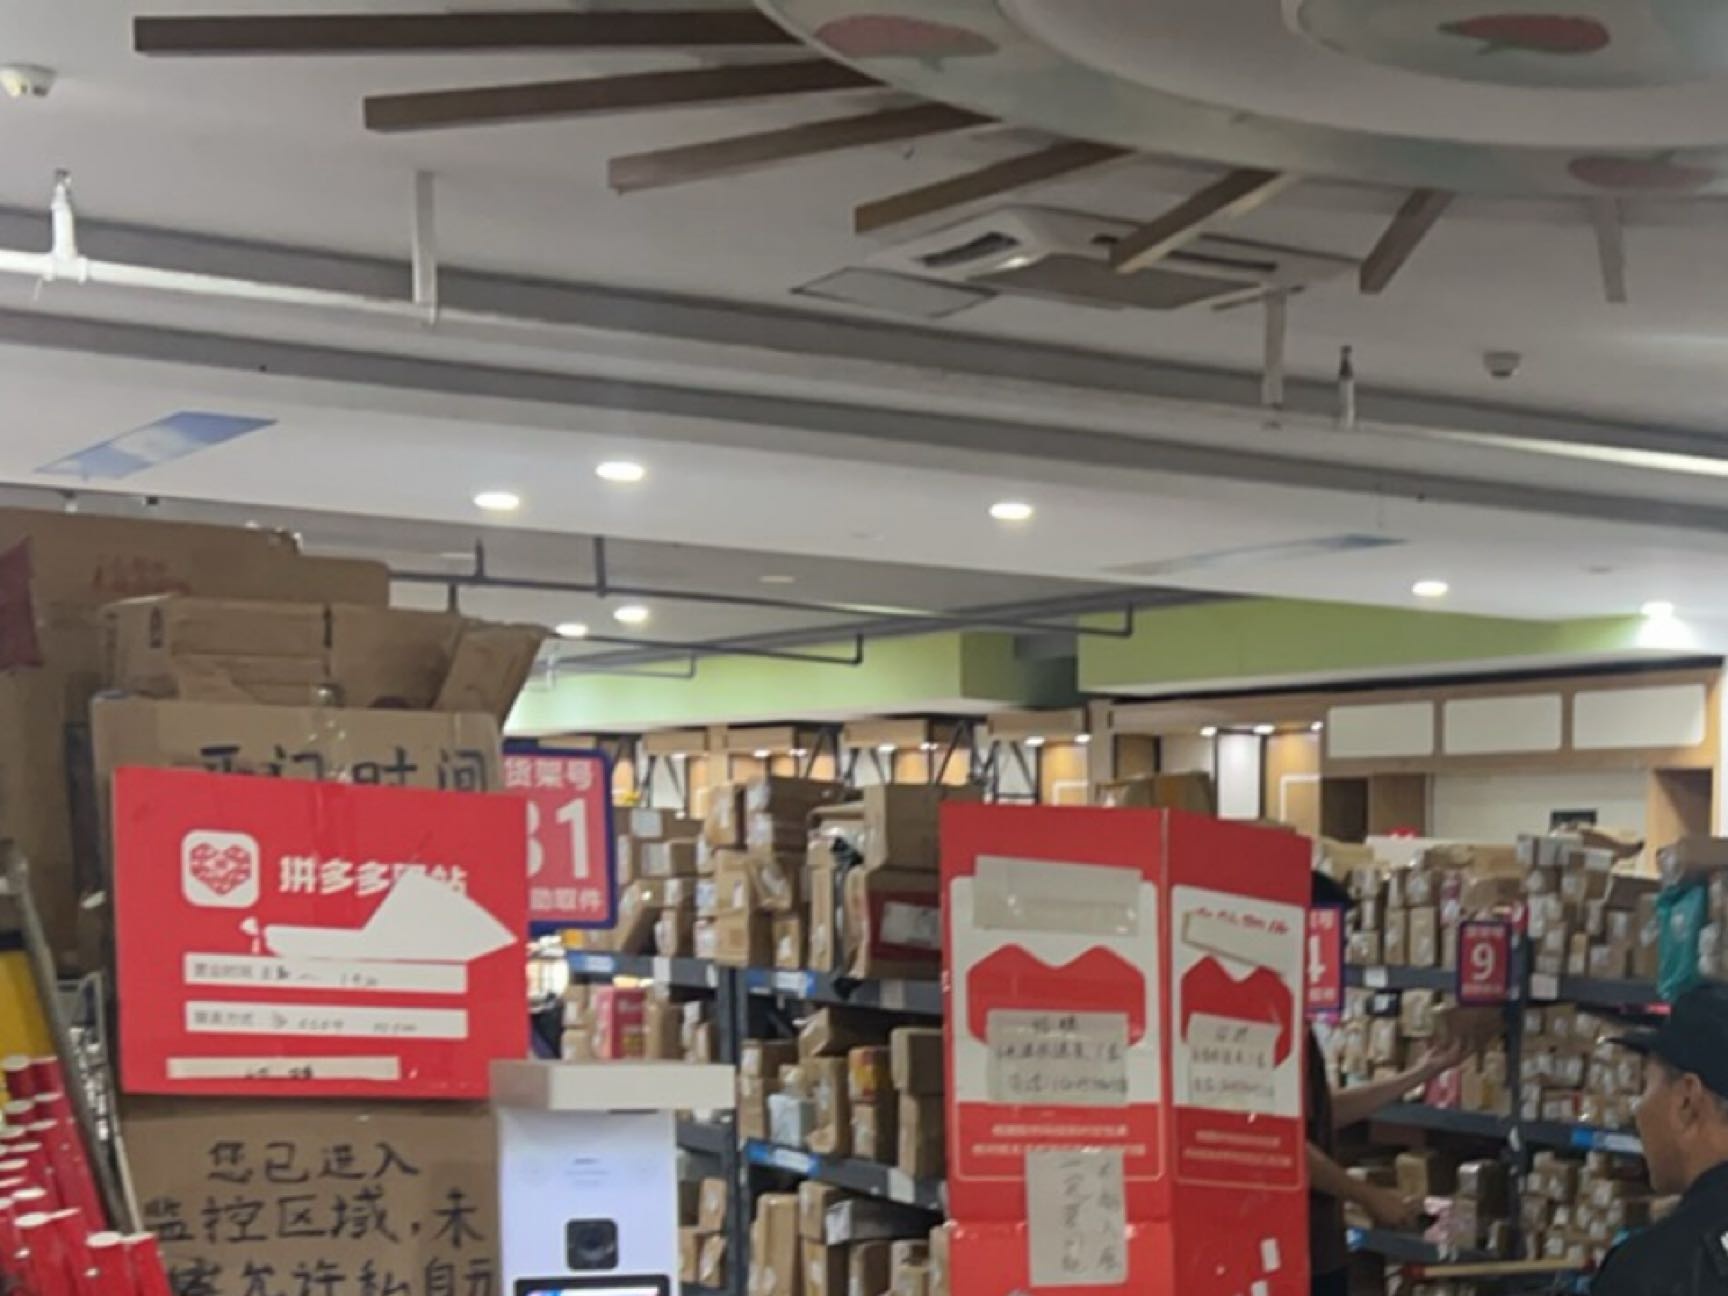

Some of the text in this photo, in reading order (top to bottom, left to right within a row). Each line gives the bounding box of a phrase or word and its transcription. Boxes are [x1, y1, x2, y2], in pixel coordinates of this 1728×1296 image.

[1470, 941, 1495, 981] 9
[206, 1140, 422, 1184] 您已进入
